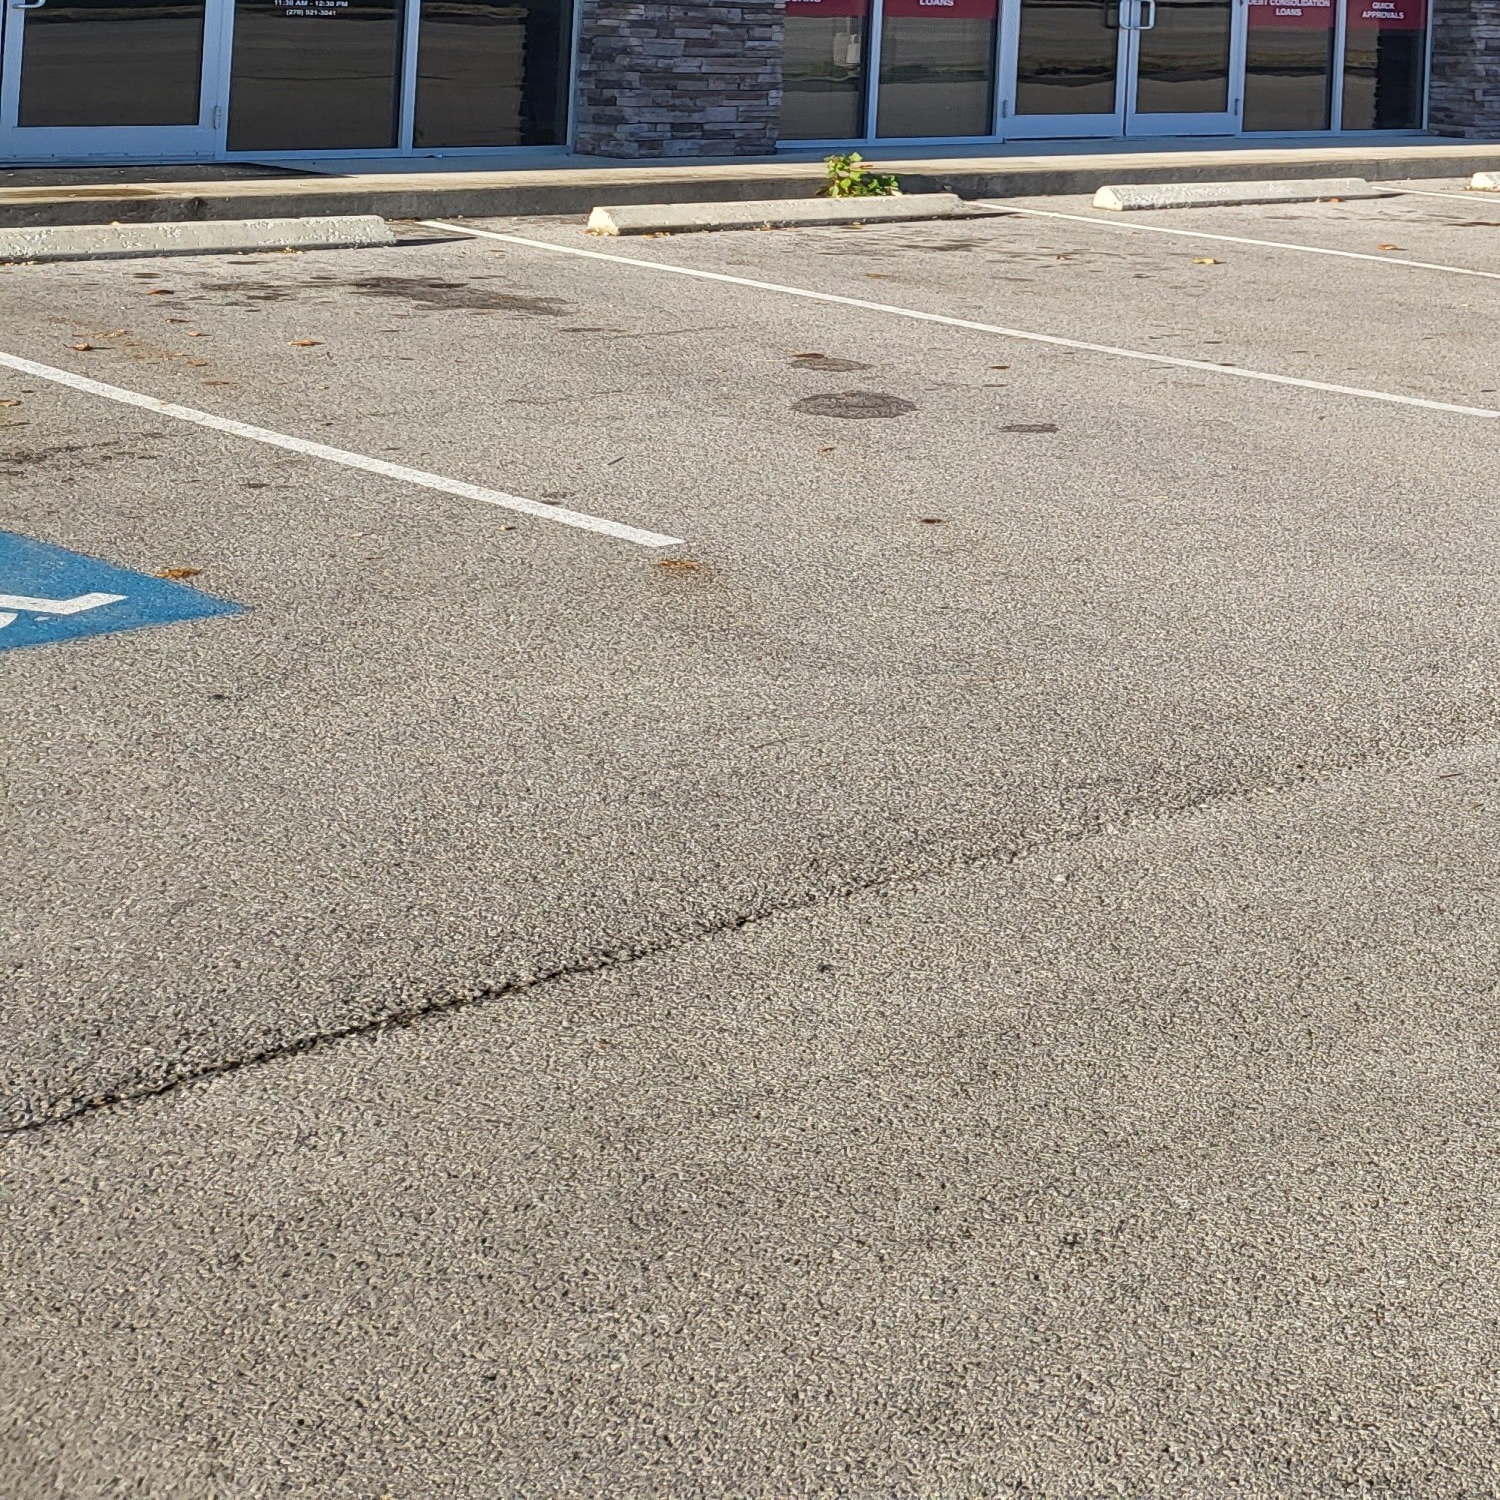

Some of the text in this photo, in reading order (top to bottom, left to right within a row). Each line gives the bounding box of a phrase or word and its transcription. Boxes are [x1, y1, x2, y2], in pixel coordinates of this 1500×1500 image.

[1371, 2, 1396, 10] QUICK
[1275, 8, 1303, 16] LOANS
[1361, 10, 1405, 20] APPROVALS
